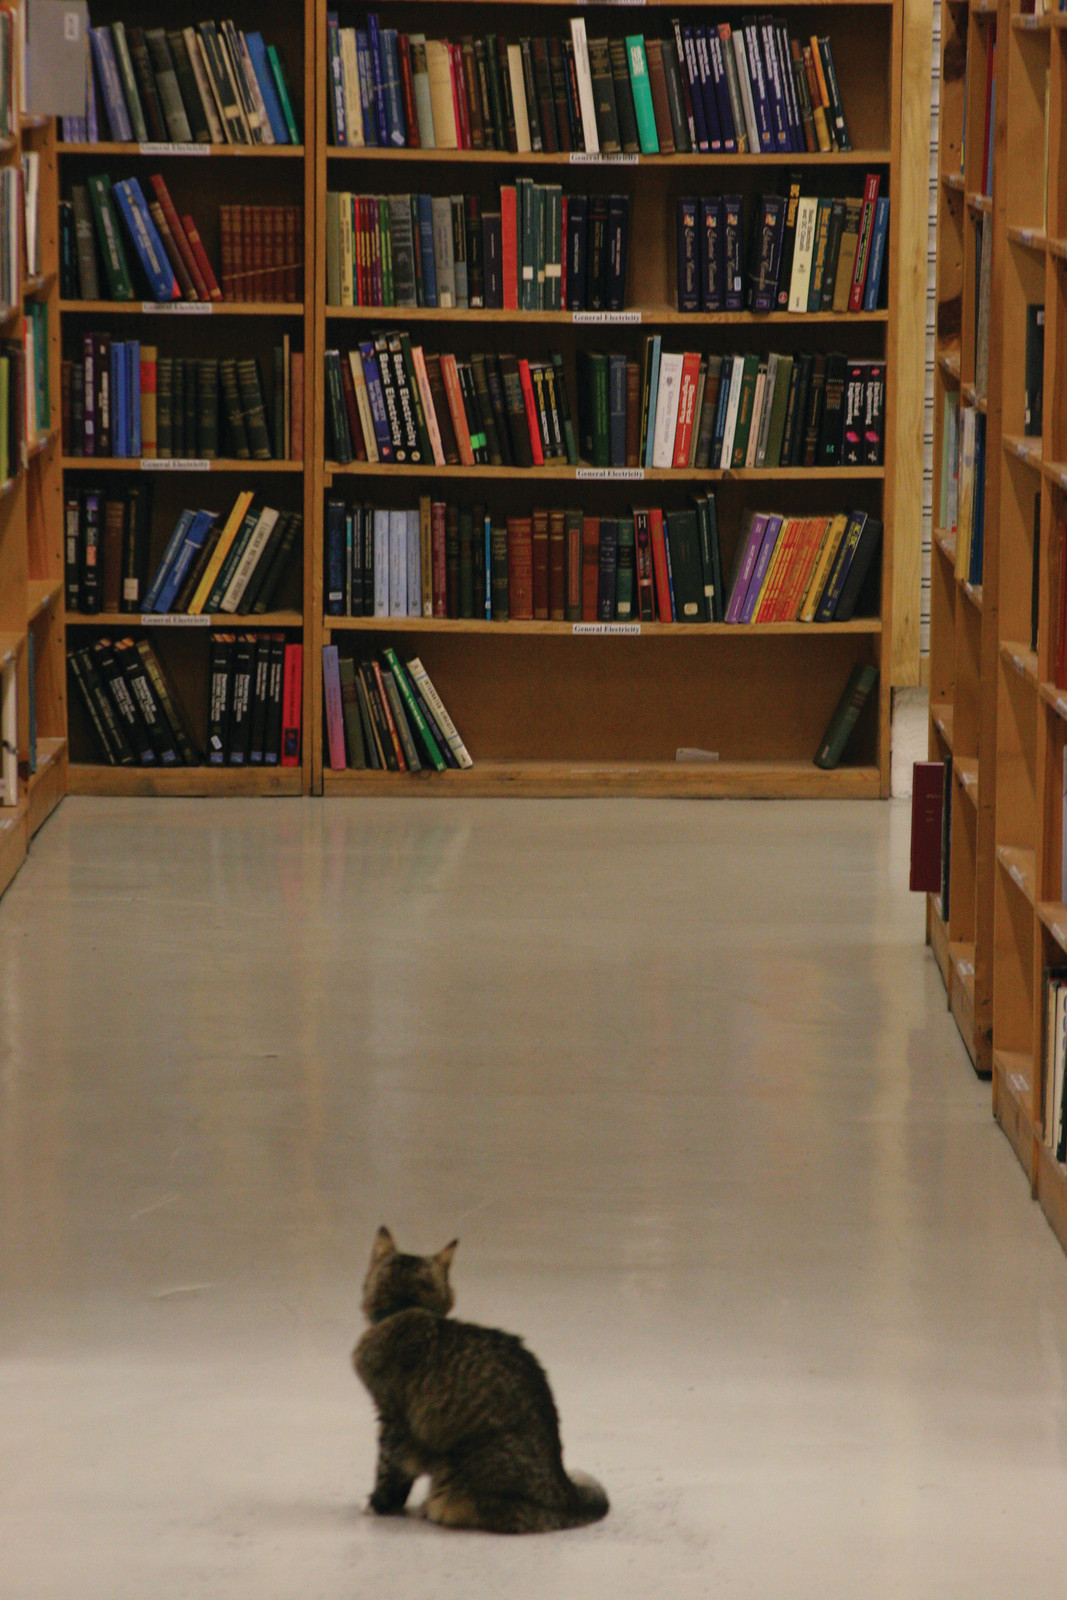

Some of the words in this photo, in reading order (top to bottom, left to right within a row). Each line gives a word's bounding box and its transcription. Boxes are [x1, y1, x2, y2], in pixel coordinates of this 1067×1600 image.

[571, 153, 599, 161] General
[602, 153, 637, 162] Electricity
[605, 314, 640, 322] Electricity
[379, 353, 391, 385] Basic
[385, 387, 402, 446] Electricity
[393, 354, 406, 386] Basic
[400, 388, 417, 447] Electricity
[846, 382, 855, 425] Engineering
[853, 382, 861, 416] Electrical
[865, 382, 874, 425] Engineering
[872, 382, 881, 416] Electrical
[607, 470, 643, 479] Electricity
[252, 527, 269, 547] LINEAR
[239, 548, 258, 577] NETWORK
[230, 578, 245, 601] THEORY
[142, 616, 169, 624] General
[172, 616, 208, 625] Electricity
[574, 625, 602, 633] General
[604, 625, 639, 635] Electricity
